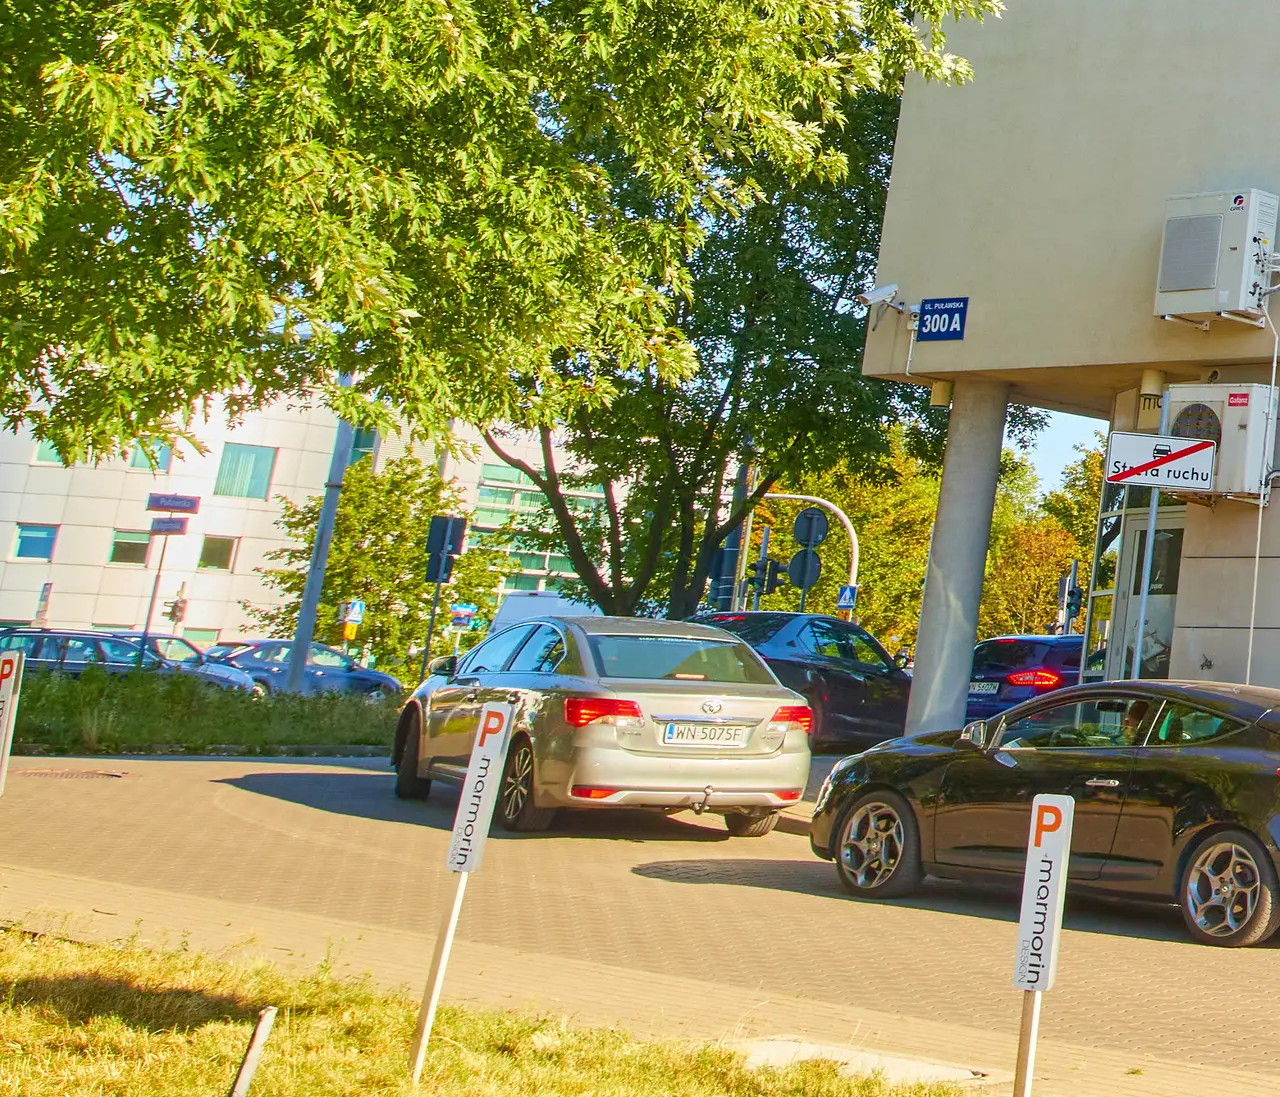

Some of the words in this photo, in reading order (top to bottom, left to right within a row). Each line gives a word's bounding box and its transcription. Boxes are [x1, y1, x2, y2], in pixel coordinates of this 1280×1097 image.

[922, 313, 949, 333] 300
[949, 313, 961, 332] A
[934, 302, 964, 310] PUŁAWSKA
[1167, 467, 1209, 482] ruchu
[478, 710, 505, 747] P
[675, 726, 696, 740] WN
[700, 727, 743, 742] 5075F
[456, 756, 491, 866] marmorin
[1033, 805, 1063, 848] P
[449, 827, 464, 865] DESIGN
[1026, 859, 1053, 984] marmorin
[1018, 939, 1030, 984] DESIGN
